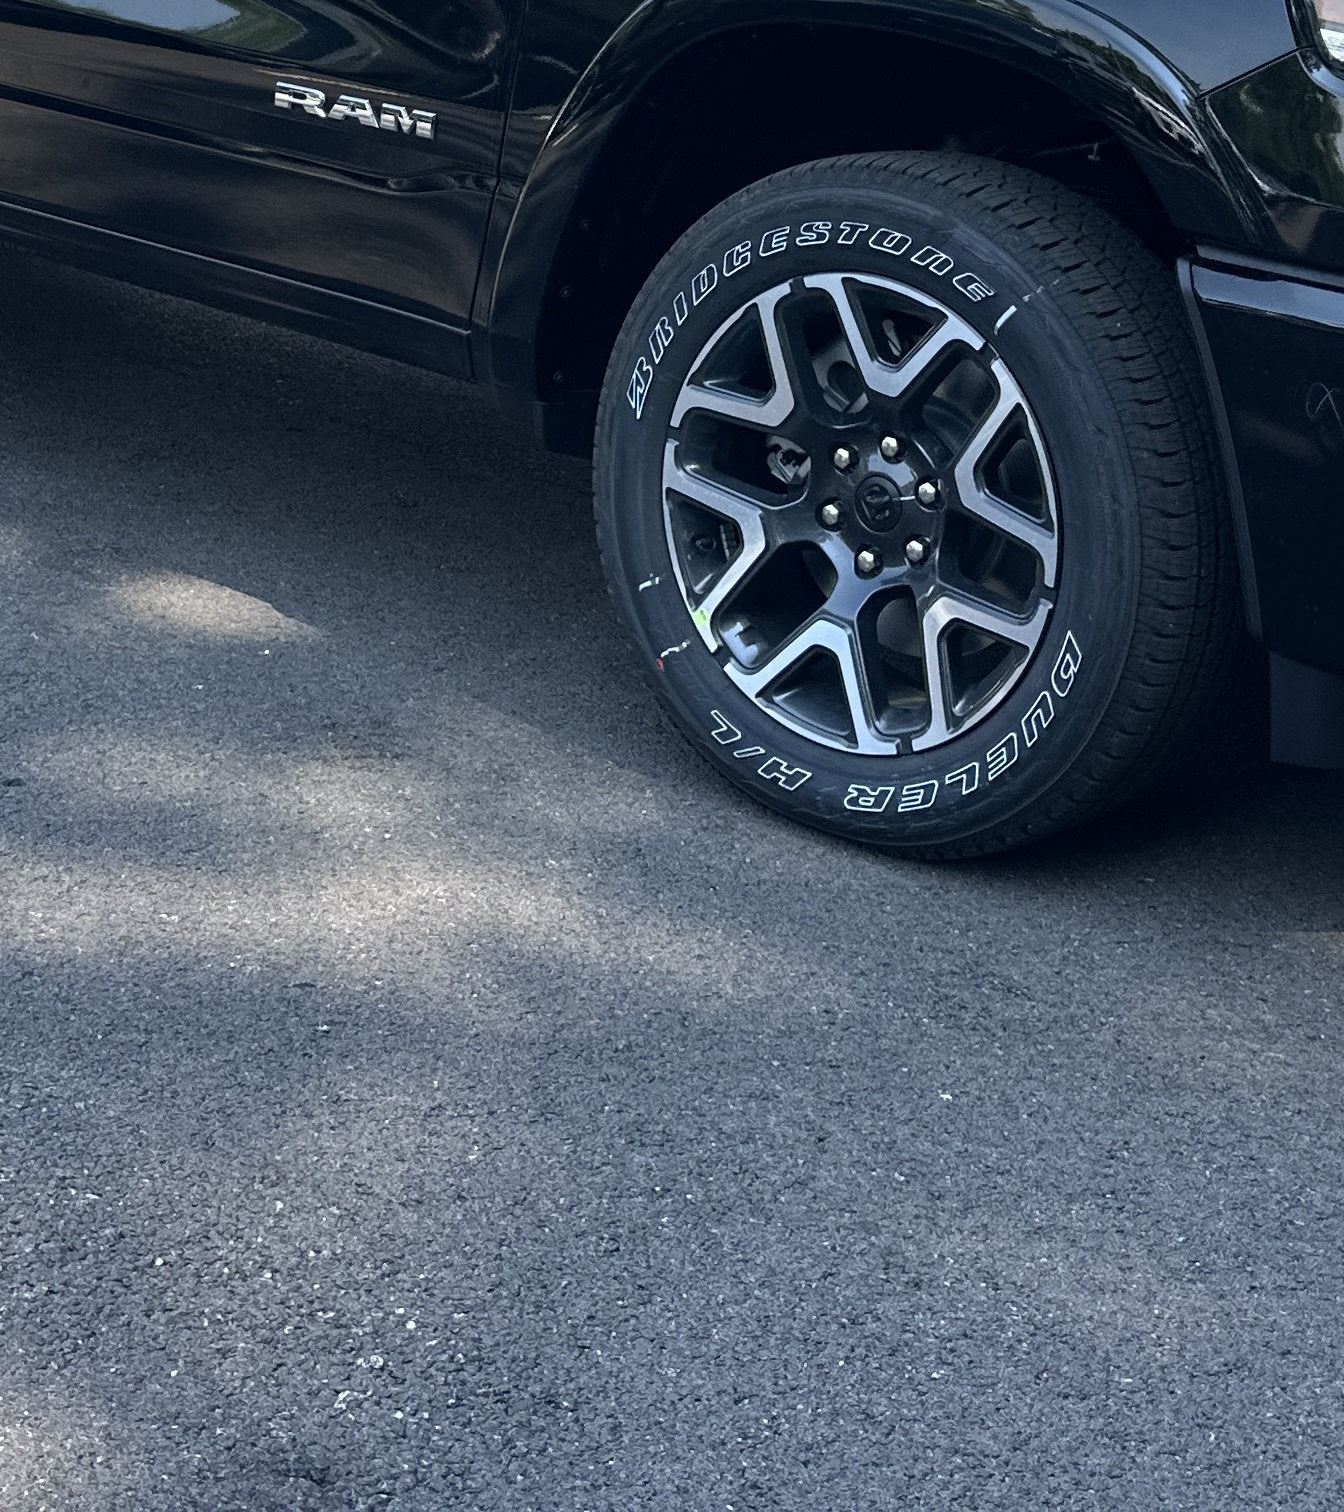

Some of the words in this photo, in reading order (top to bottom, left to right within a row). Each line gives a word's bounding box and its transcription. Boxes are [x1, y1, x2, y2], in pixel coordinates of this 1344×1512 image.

[274, 81, 438, 140] RAM
[626, 221, 995, 420] BRIDGESTONE
[711, 709, 813, 791] H/L
[843, 629, 1083, 813] DUELER
